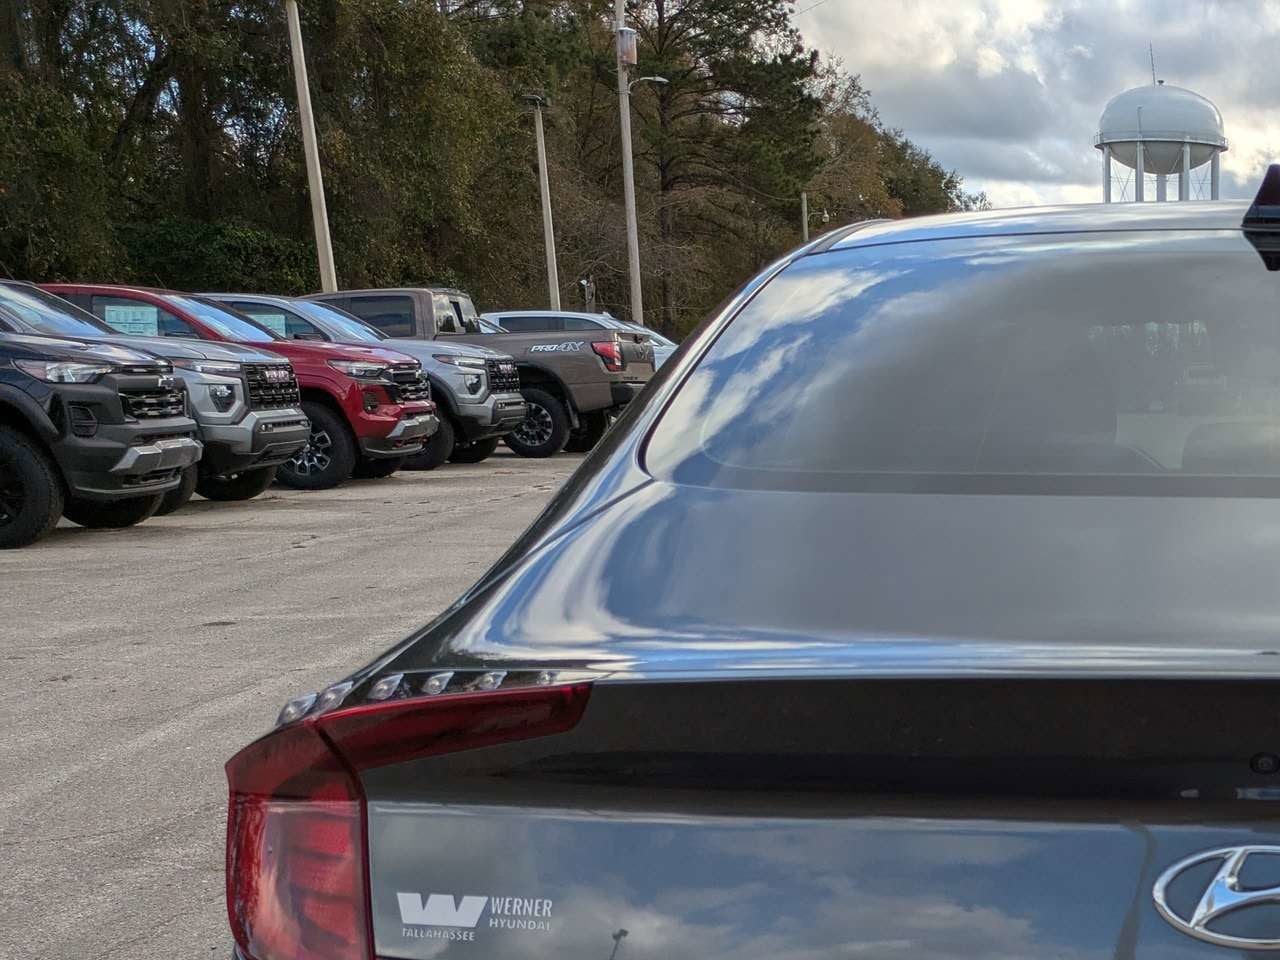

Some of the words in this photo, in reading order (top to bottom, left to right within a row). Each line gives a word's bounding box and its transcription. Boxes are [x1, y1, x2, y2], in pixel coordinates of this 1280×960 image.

[491, 897, 553, 917] WERNER
[489, 918, 551, 931] HYUNDAI
[402, 928, 476, 941] TALLAHASSEE
